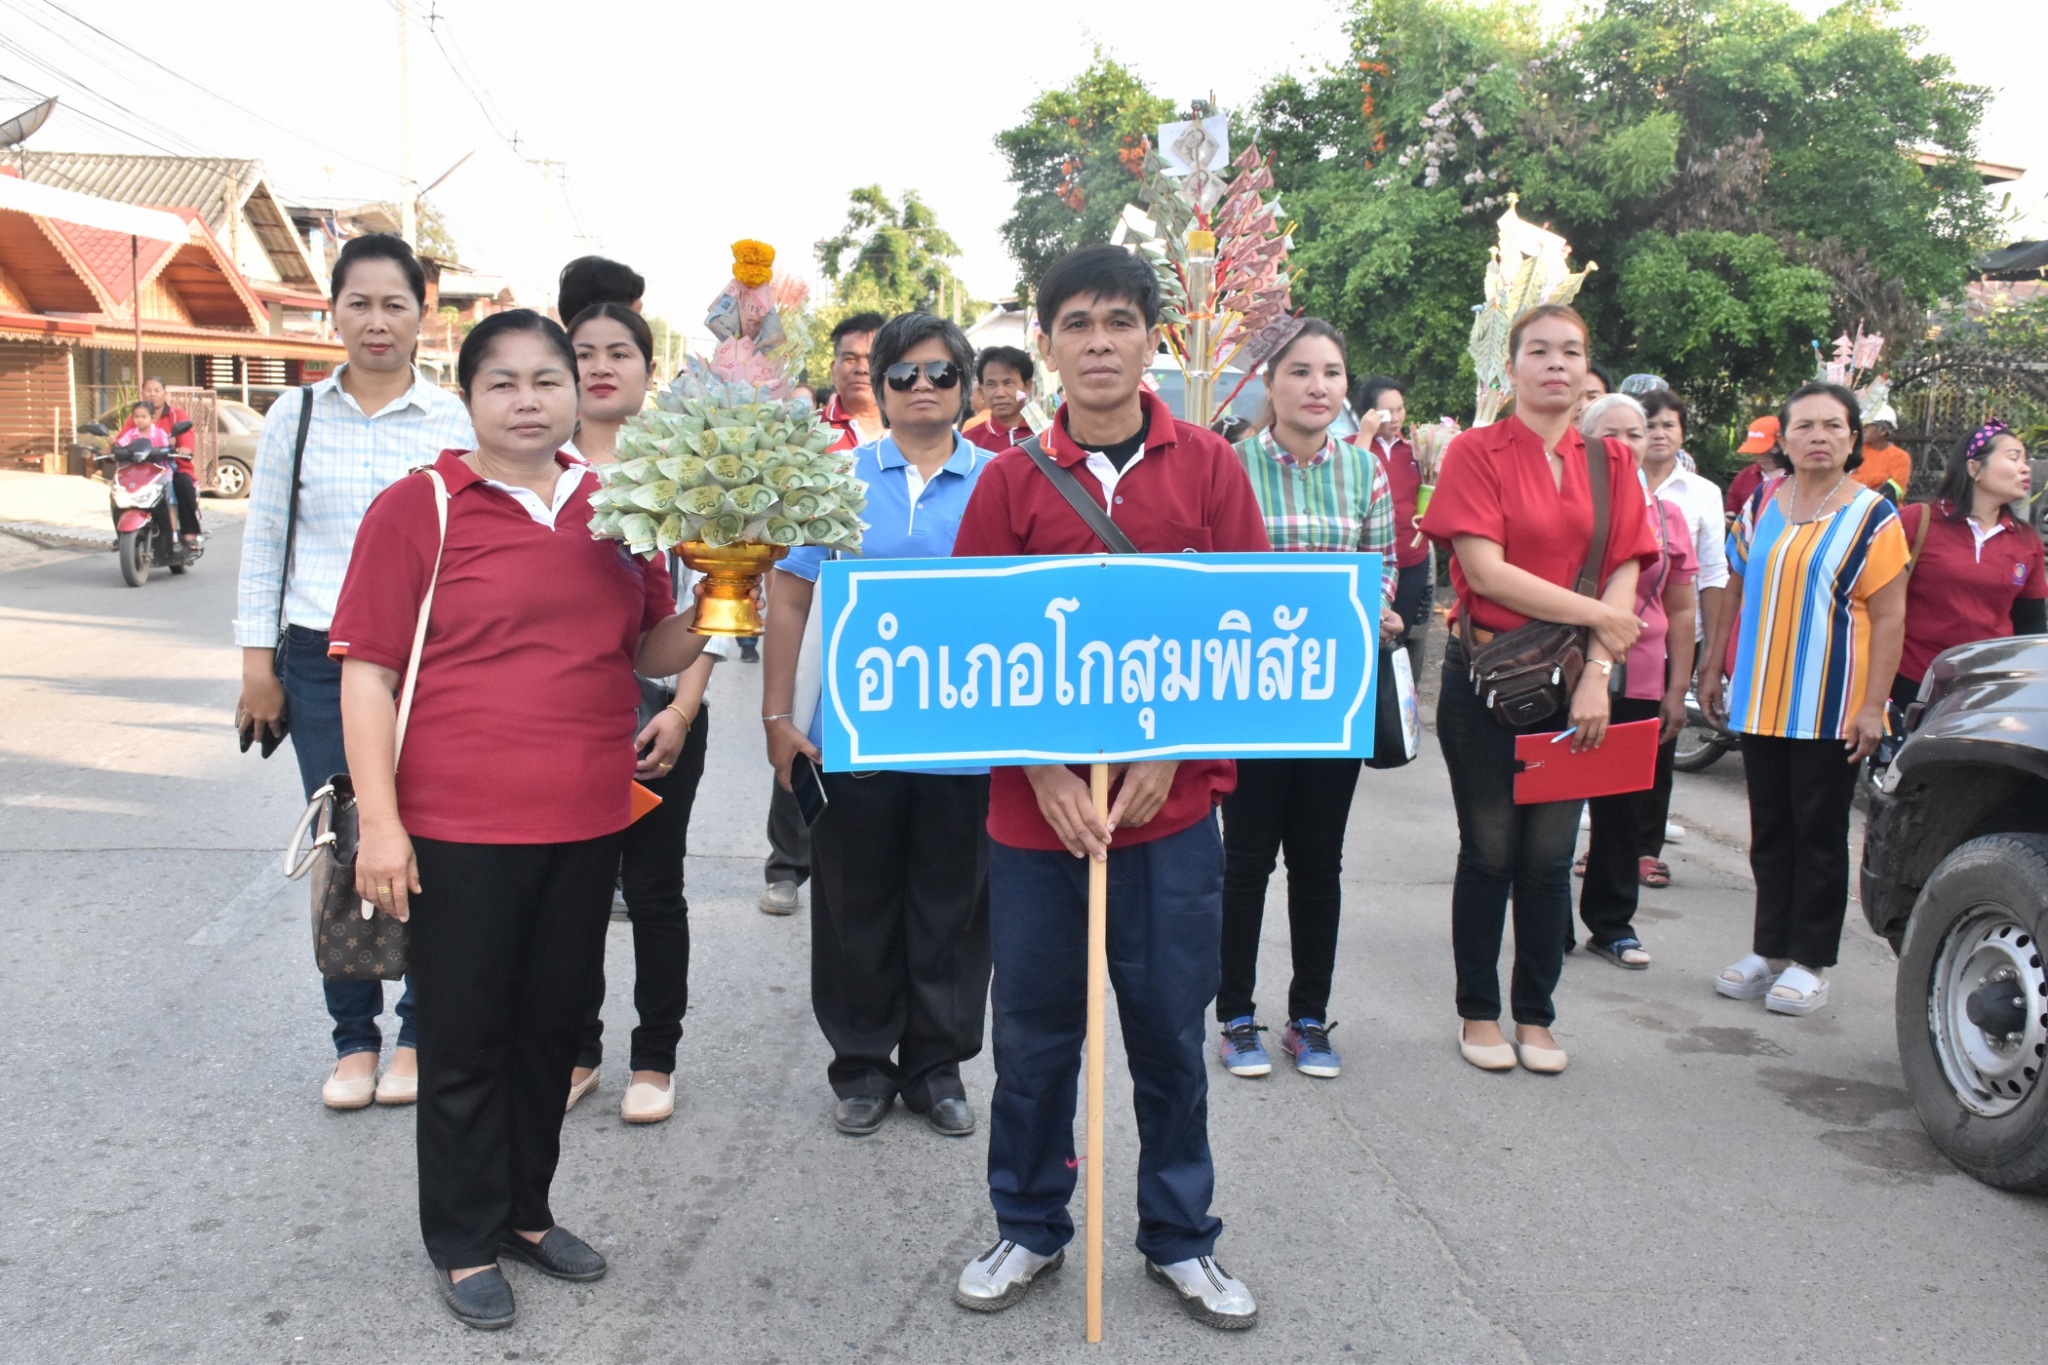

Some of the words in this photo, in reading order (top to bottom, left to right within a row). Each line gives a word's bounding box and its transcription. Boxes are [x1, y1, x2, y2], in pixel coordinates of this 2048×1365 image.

[856, 597, 1336, 740] อำเภอโกสุมพิสัย
